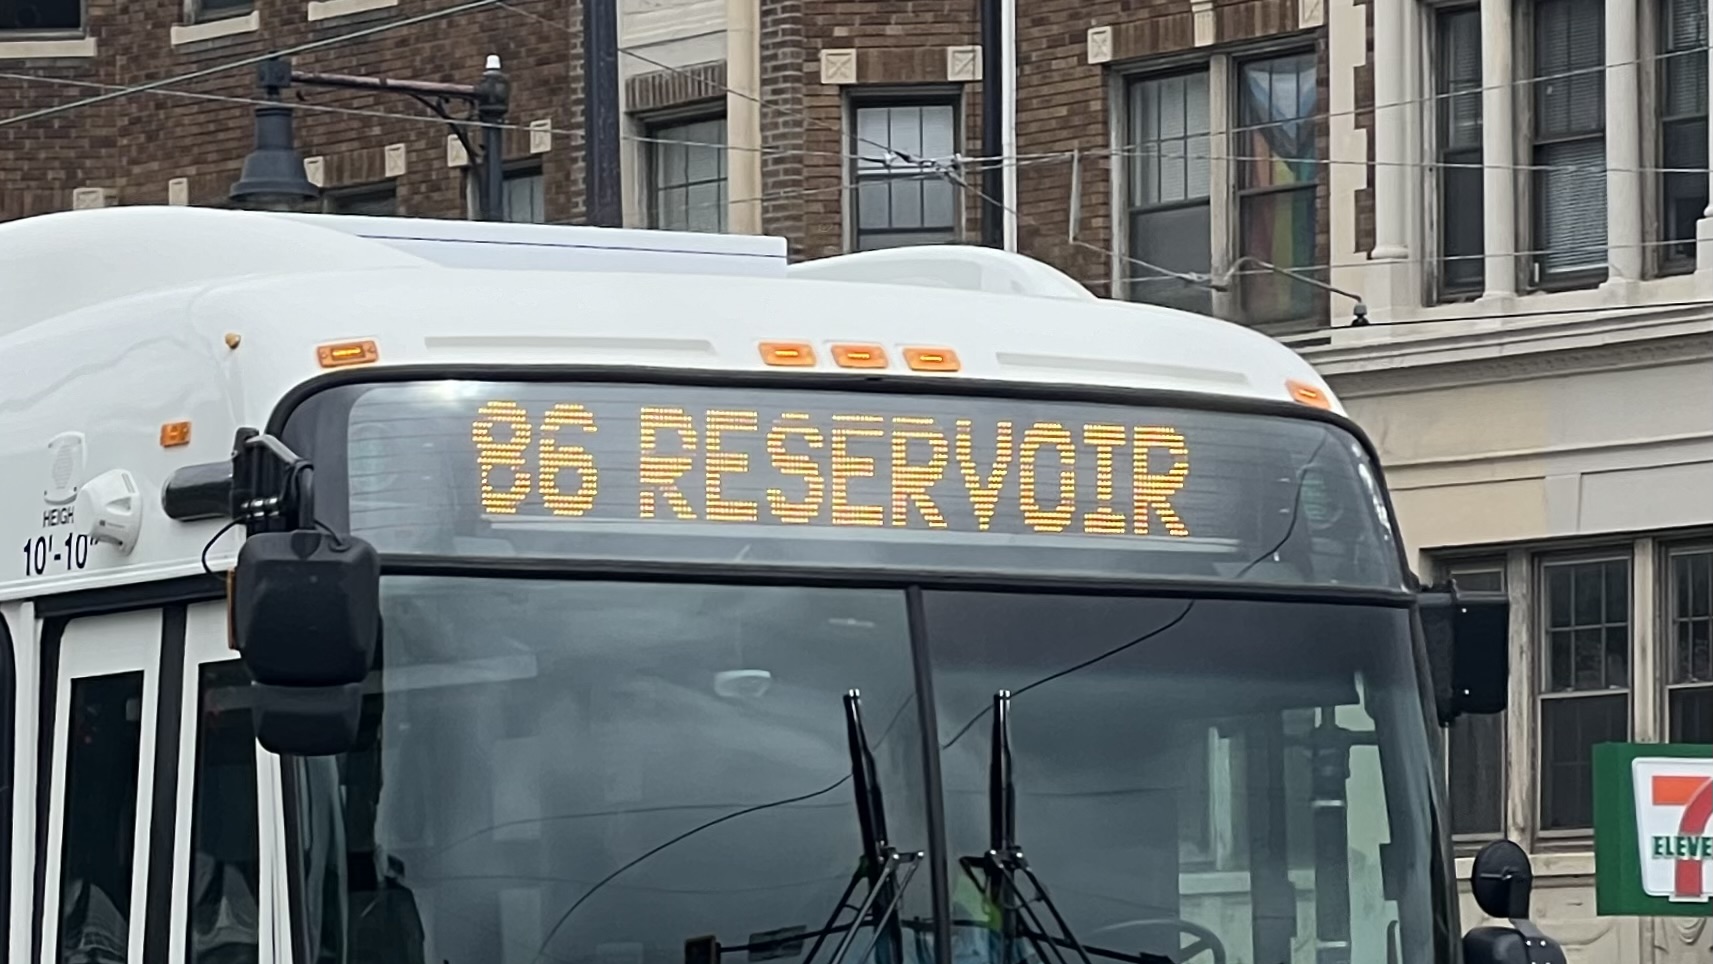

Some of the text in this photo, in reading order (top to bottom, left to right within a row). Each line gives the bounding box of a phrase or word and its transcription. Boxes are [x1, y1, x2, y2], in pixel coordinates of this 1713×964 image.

[43, 505, 75, 529] HEIGH
[472, 401, 1189, 537] 86 RESERVOIR
[1651, 775, 1713, 898] 7
